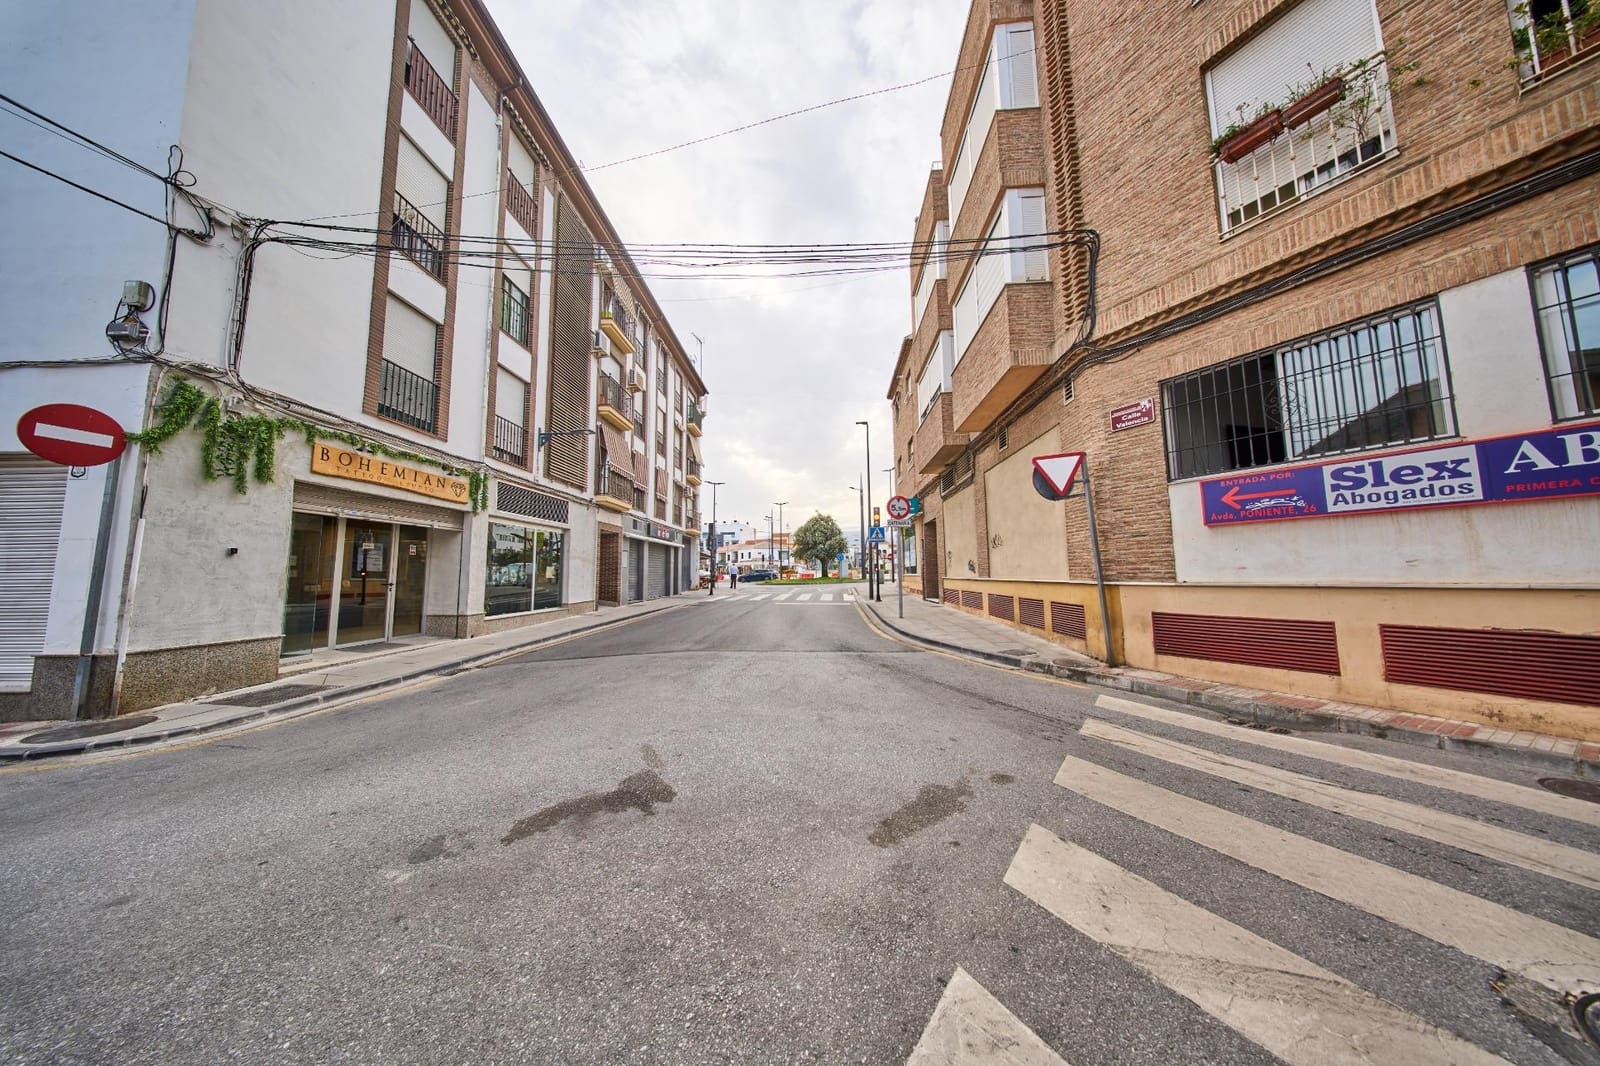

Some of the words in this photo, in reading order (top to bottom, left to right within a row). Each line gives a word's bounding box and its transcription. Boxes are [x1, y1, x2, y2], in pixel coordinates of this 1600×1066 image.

[1116, 417, 1149, 428] Valencia
[1121, 412, 1141, 421] Calle
[320, 446, 446, 489] BOHEMIAN
[1330, 457, 1473, 493] Slex
[1220, 476, 1266, 487] ENTRADA
[1270, 471, 1296, 480] POR:
[1505, 478, 1583, 493] PRIMERA
[1332, 482, 1475, 506] Abogados
[1210, 512, 1238, 521] Avda.
[1240, 505, 1299, 518] PONIENTE,
[1303, 504, 1317, 513] 26
